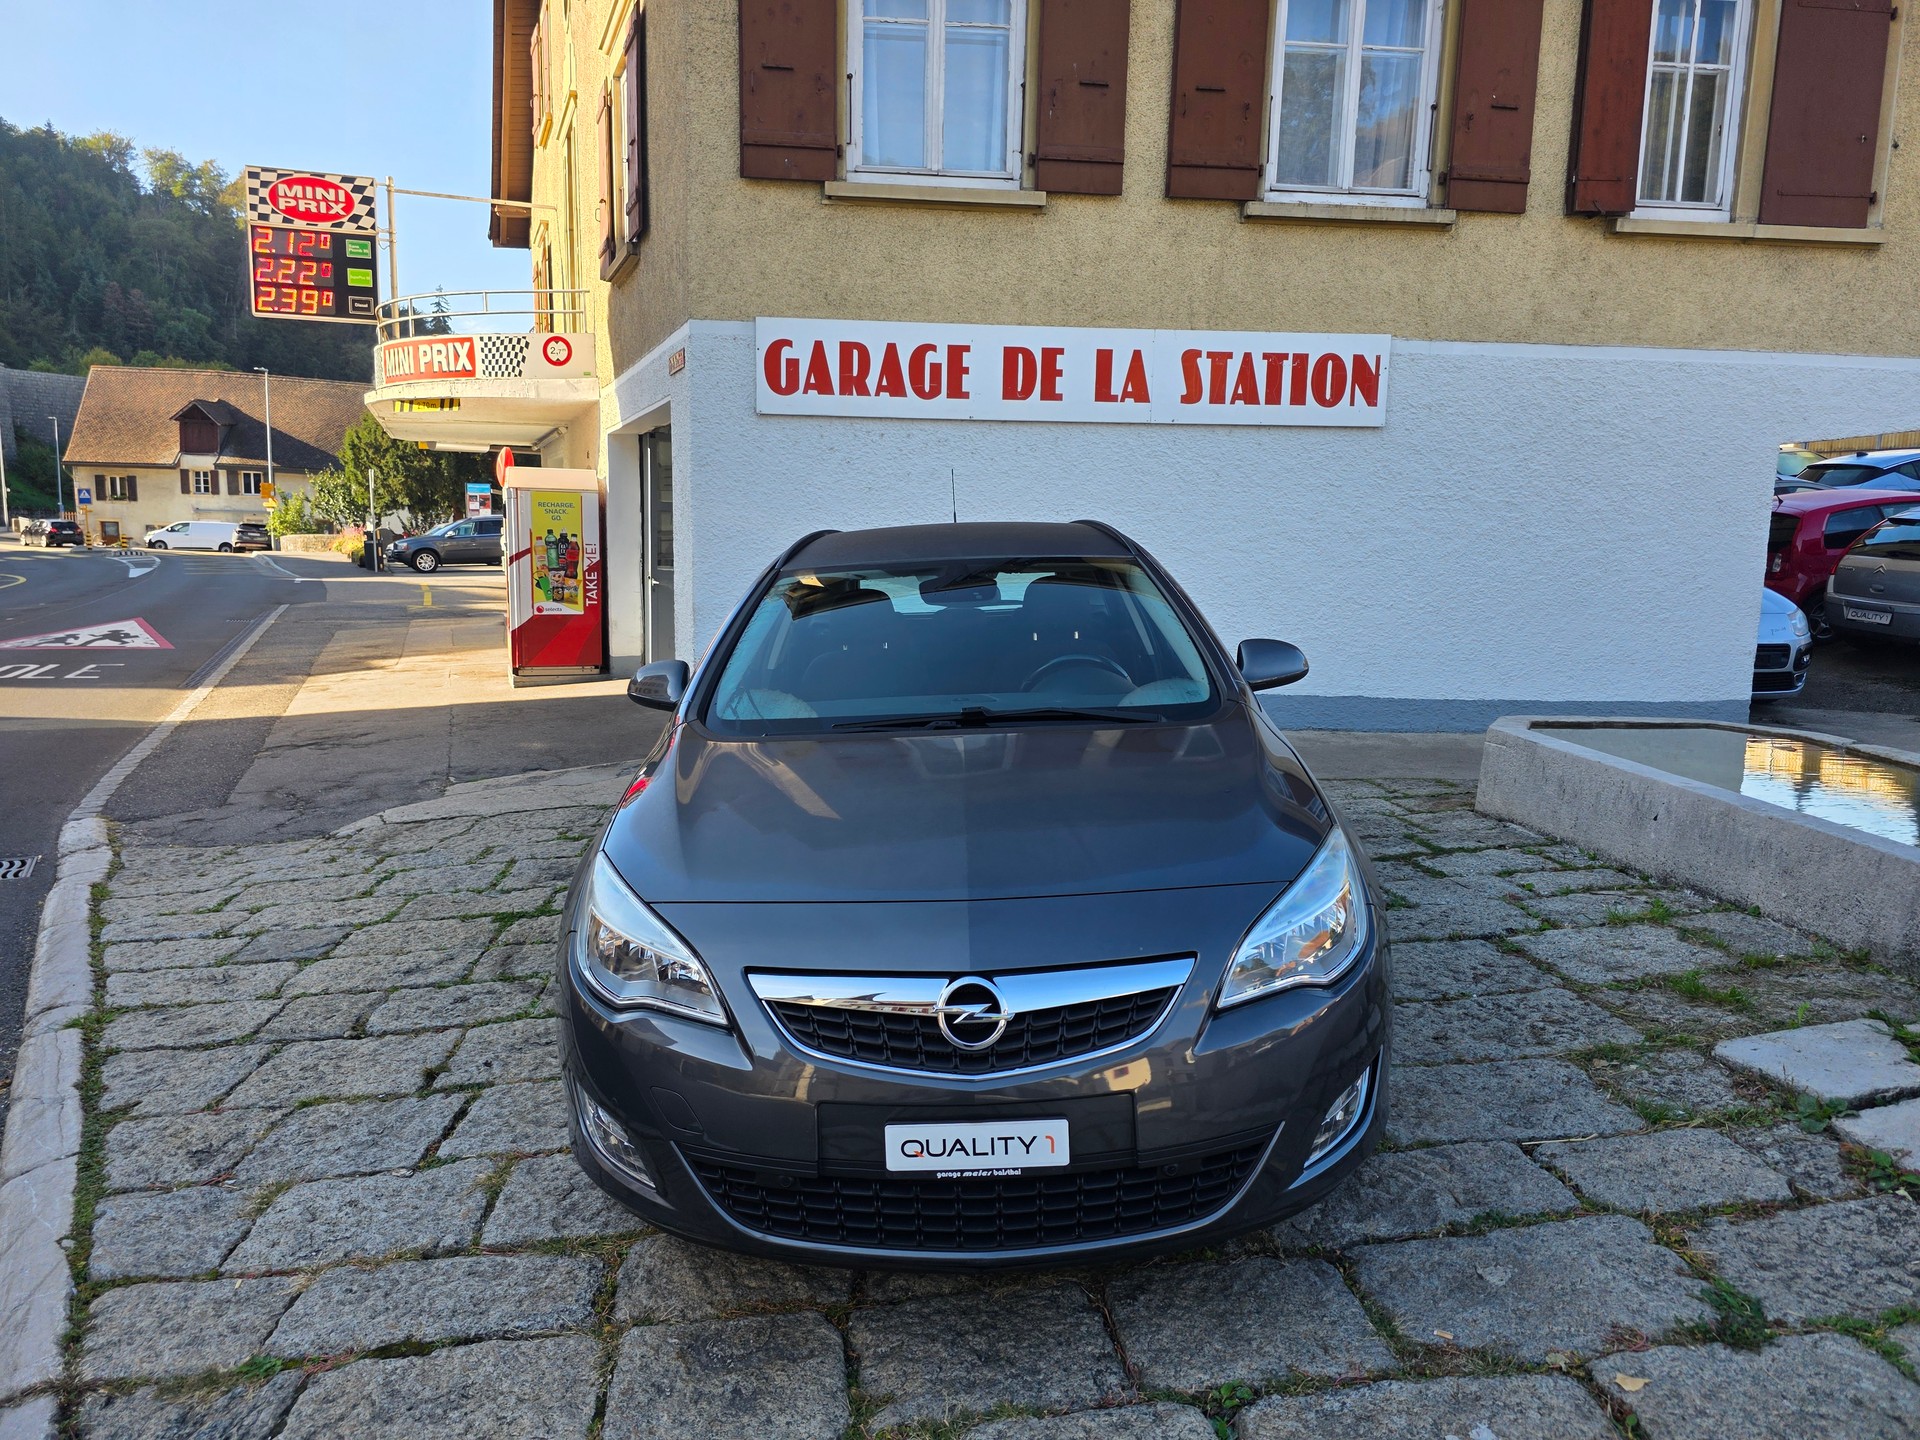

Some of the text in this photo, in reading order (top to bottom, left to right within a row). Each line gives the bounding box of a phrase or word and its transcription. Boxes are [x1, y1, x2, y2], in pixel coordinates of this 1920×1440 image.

[278, 183, 346, 203] MINI
[278, 198, 347, 216] PRIX
[385, 341, 473, 377] MINI PRIX
[764, 338, 1381, 408] GARAGE DE LA STATION
[537, 501, 575, 509] RECHARGE.
[585, 543, 598, 607] TAKE ME!
[1850, 610, 1884, 621] QUALITY
[900, 1136, 1038, 1158] QUALITY
[936, 1171, 961, 1179] garage
